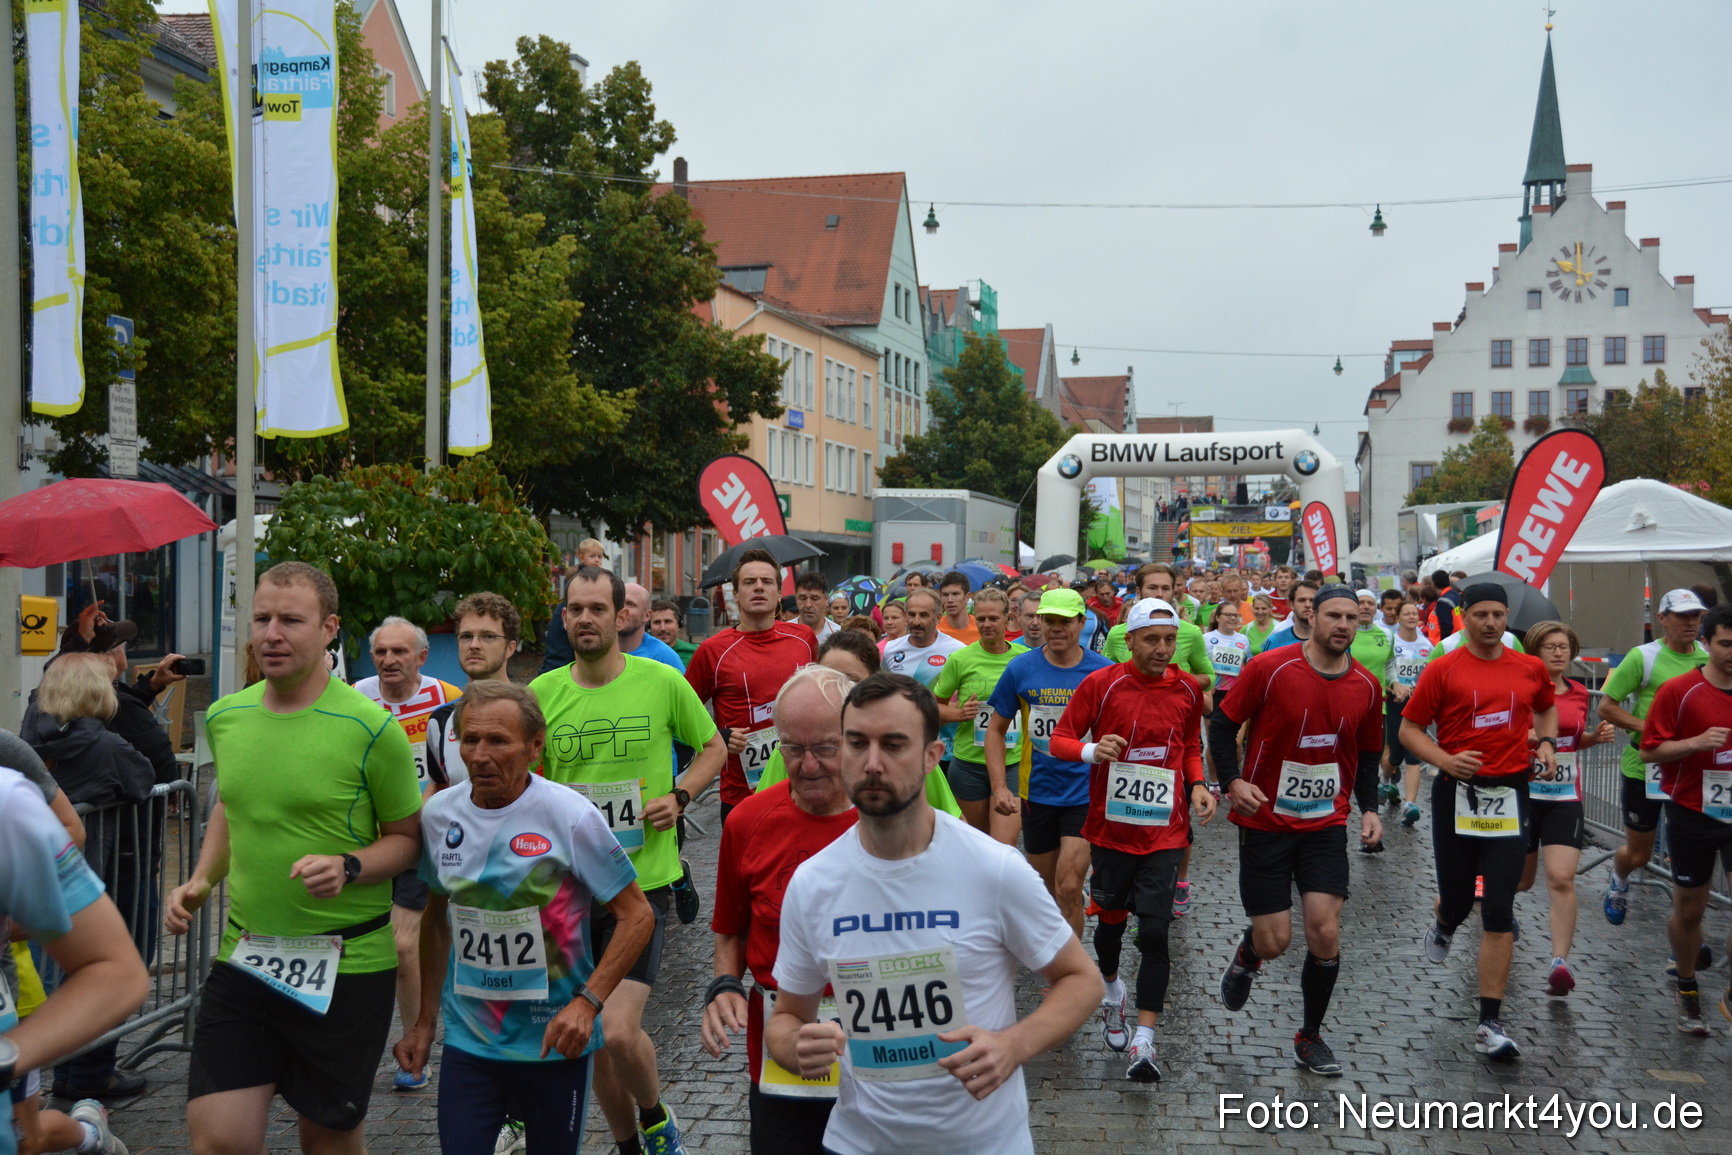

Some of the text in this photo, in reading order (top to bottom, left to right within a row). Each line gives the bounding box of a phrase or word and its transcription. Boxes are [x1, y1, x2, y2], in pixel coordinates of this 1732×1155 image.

[1091, 441, 1285, 466] BMW Laufsport
[1504, 450, 1591, 584] REWE
[1230, 525, 1253, 535] ZIEL
[1215, 652, 1241, 666] 2682
[1028, 689, 1039, 697] 10.
[592, 782, 633, 795] BOCK
[1113, 776, 1168, 805] 2462
[1284, 776, 1335, 799] 2538
[593, 799, 636, 828] 14
[1125, 805, 1153, 817] Daniel
[1470, 819, 1503, 829] Michael
[515, 838, 548, 852] Hervis
[442, 852, 463, 861] PARTL
[484, 911, 532, 926] BOCK
[833, 910, 960, 937] PUMA
[280, 937, 333, 951] BOCK
[460, 927, 537, 967] 2412
[878, 952, 945, 975] BOCK
[480, 974, 513, 988] Josef
[845, 979, 954, 1034] 2446
[872, 1040, 936, 1064] Manuel
